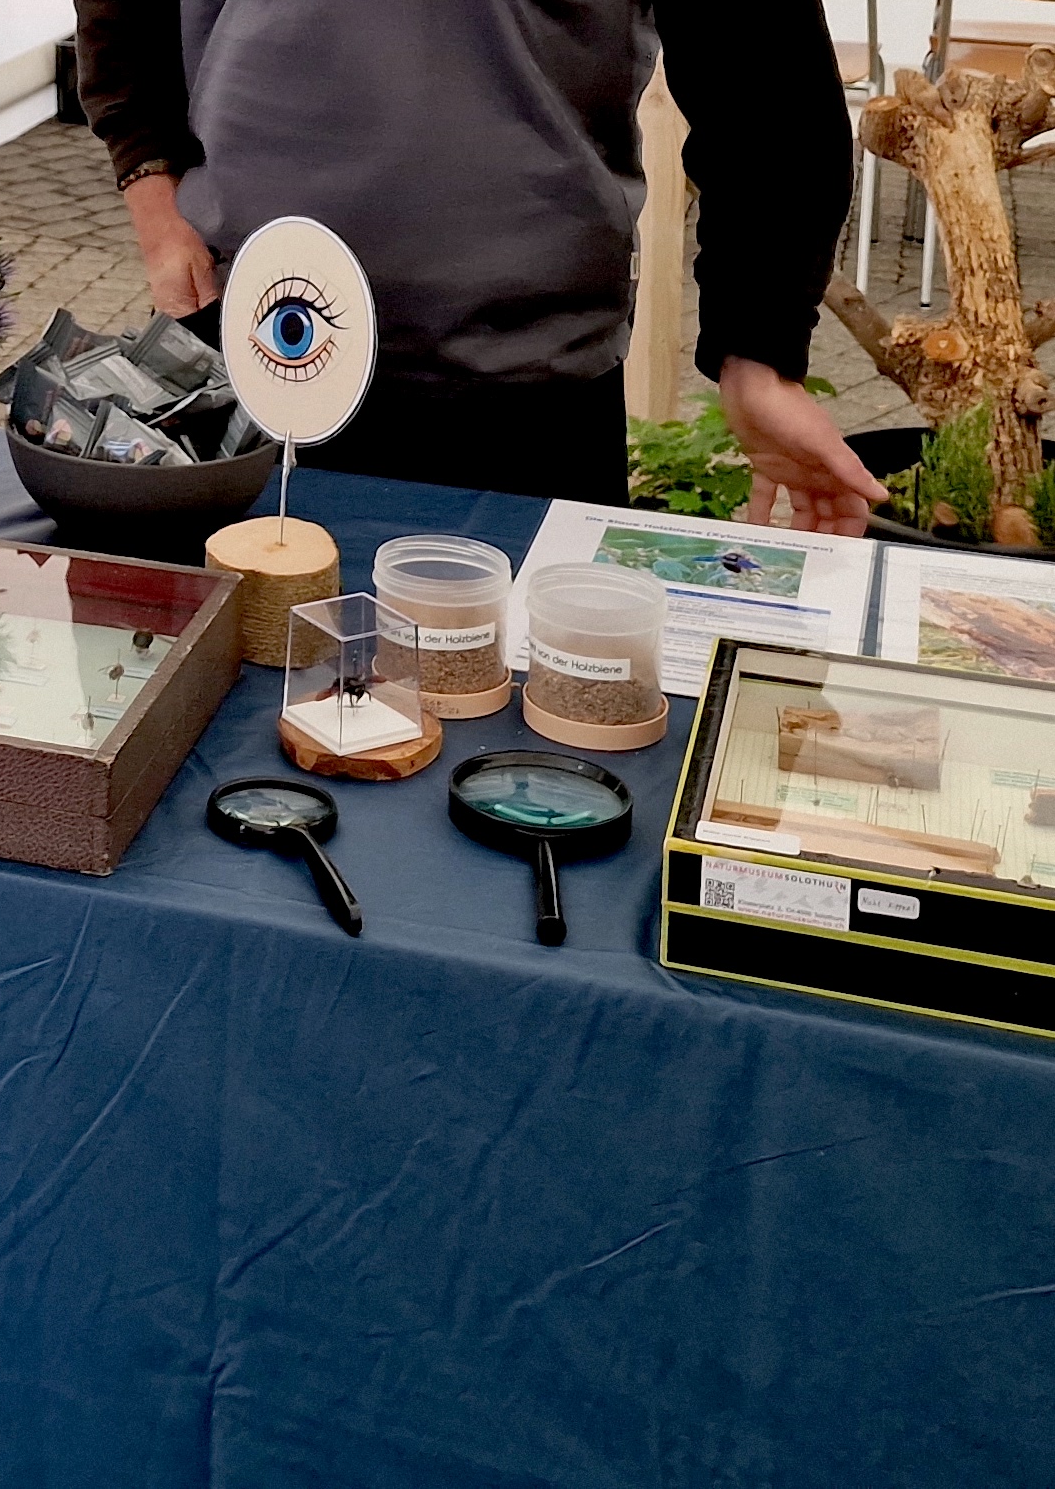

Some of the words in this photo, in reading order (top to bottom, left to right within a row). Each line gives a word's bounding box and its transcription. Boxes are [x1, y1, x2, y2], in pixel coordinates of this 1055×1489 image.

[425, 633, 442, 643] der
[446, 631, 490, 644] Holzbiene
[552, 655, 568, 666] der
[572, 660, 623, 673] Holzbiene
